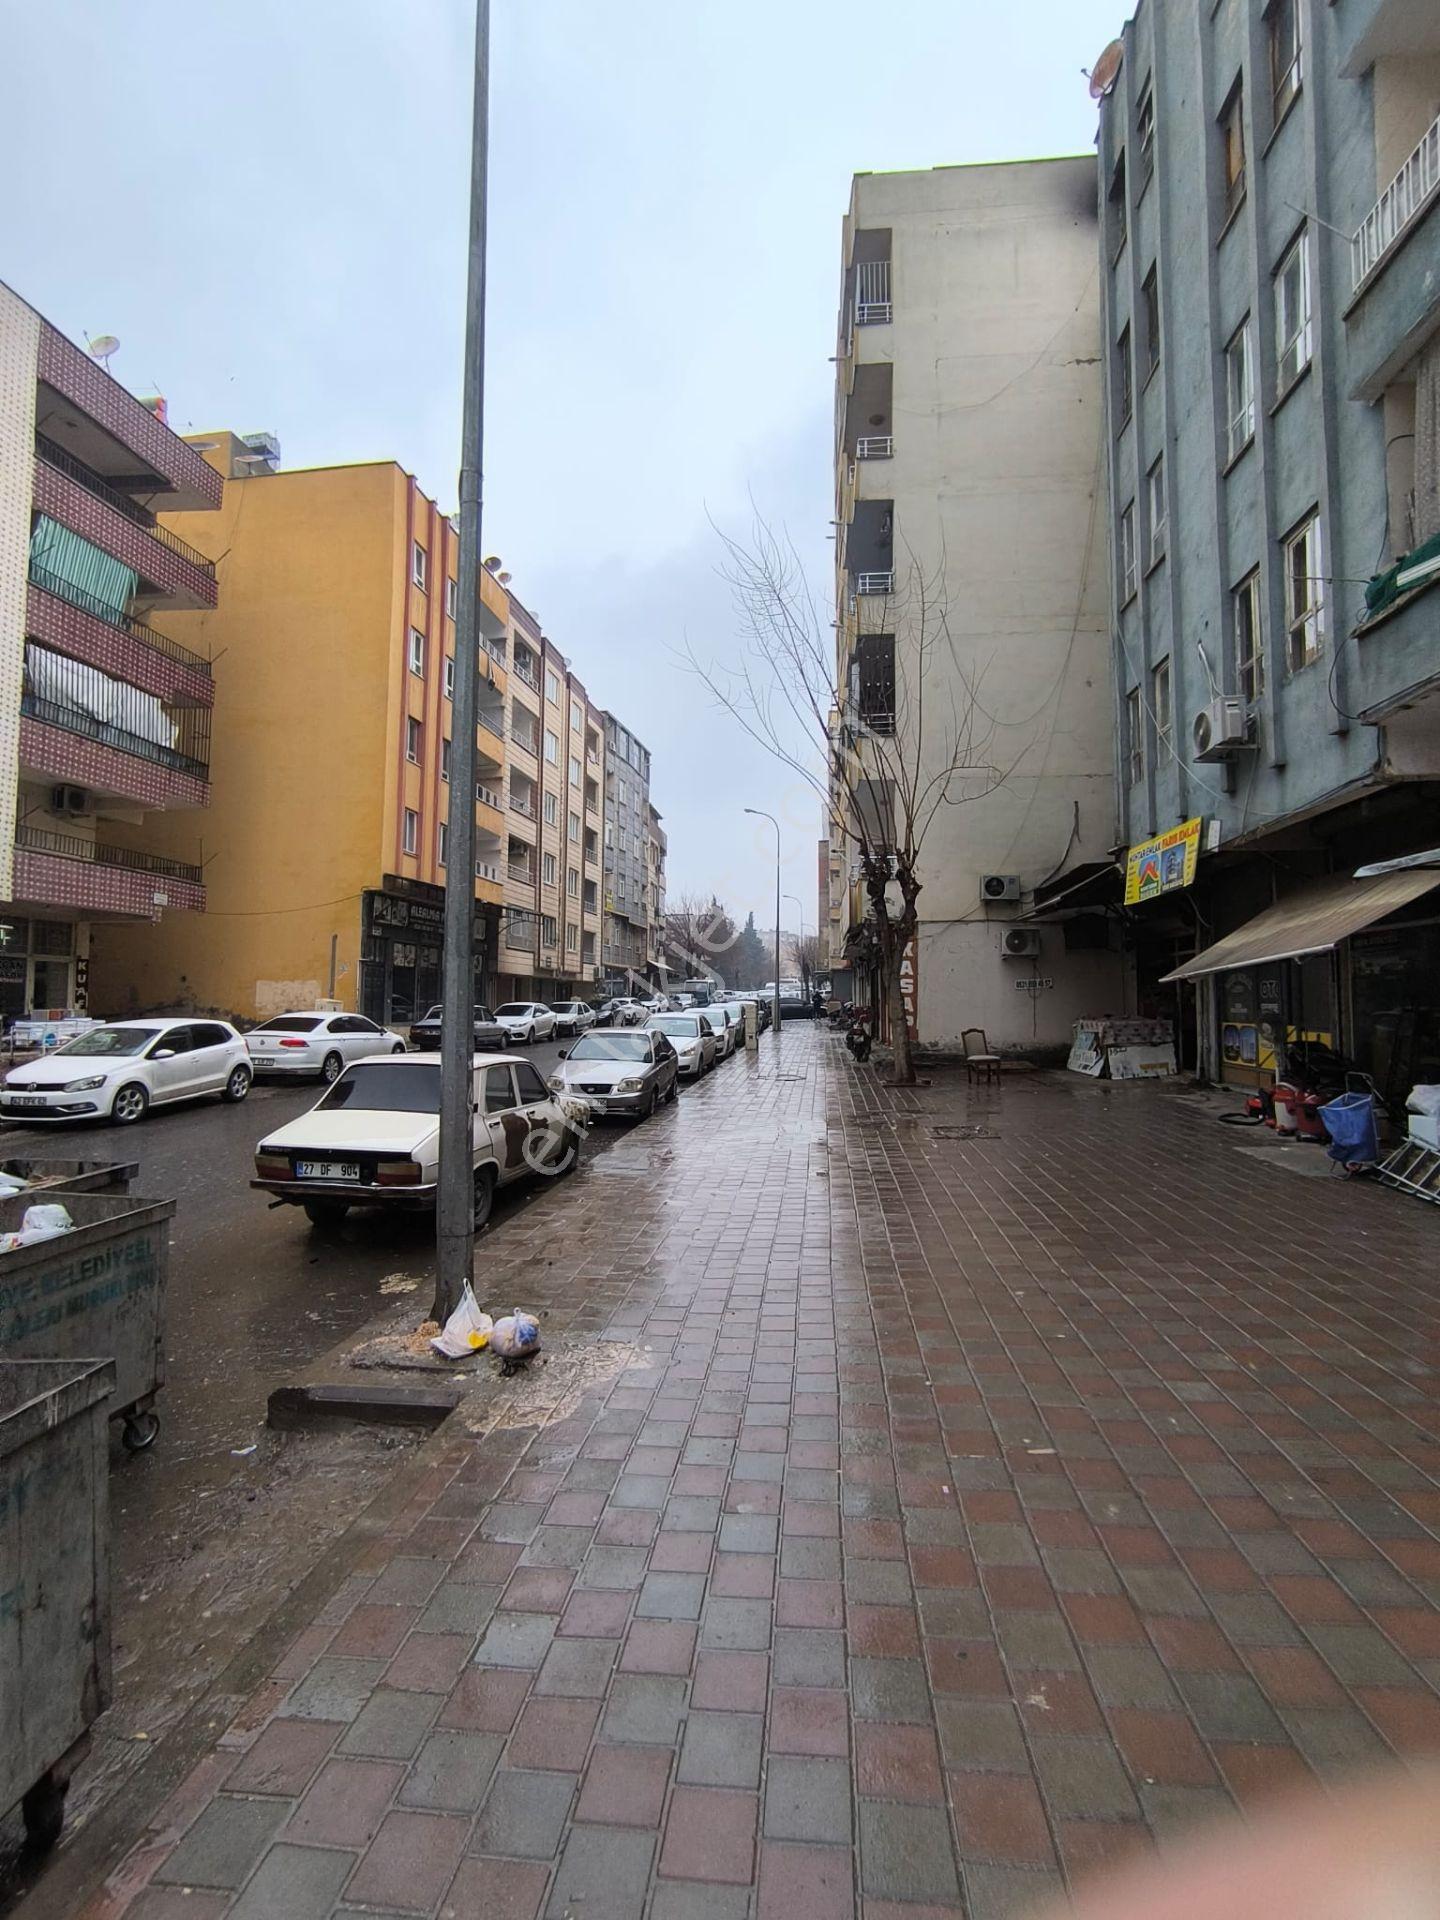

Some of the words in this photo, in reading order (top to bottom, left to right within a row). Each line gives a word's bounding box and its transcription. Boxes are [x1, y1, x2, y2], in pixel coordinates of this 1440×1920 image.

[304, 1163, 314, 1175] 27
[320, 1164, 332, 1176] DF
[341, 1164, 358, 1177] 904
